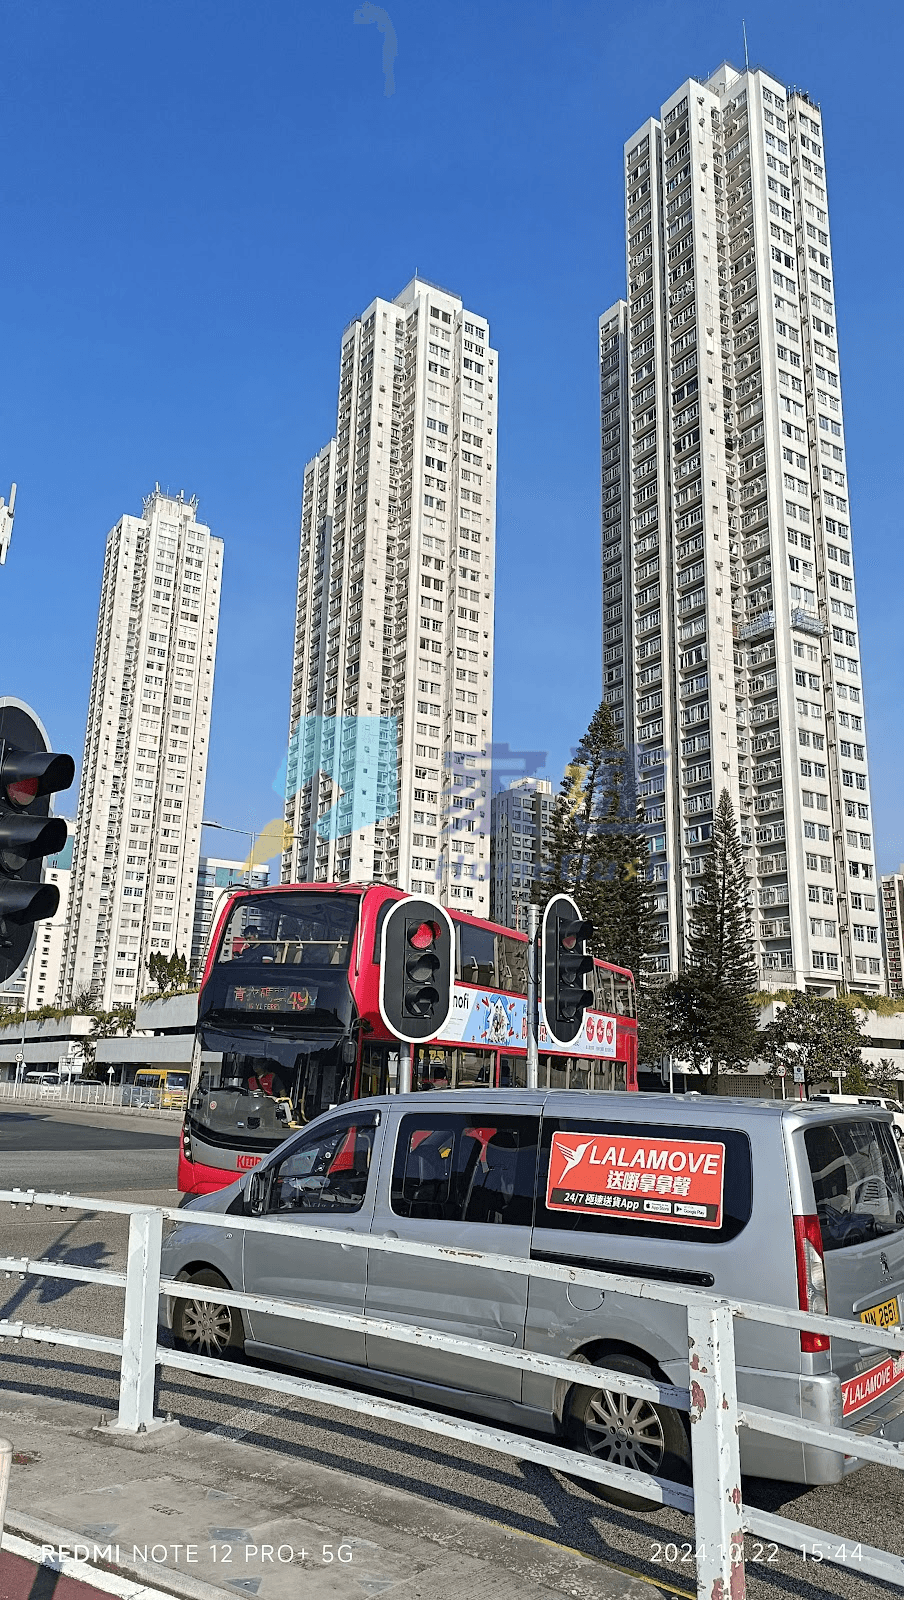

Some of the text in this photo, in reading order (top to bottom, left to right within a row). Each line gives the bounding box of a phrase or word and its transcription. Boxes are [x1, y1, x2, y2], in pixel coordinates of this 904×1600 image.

[453, 992, 469, 1010] nofi
[589, 1145, 721, 1175] LALAMOVE
[564, 1192, 585, 1204] 24/7
[849, 1365, 891, 1406] LALAMOVE
